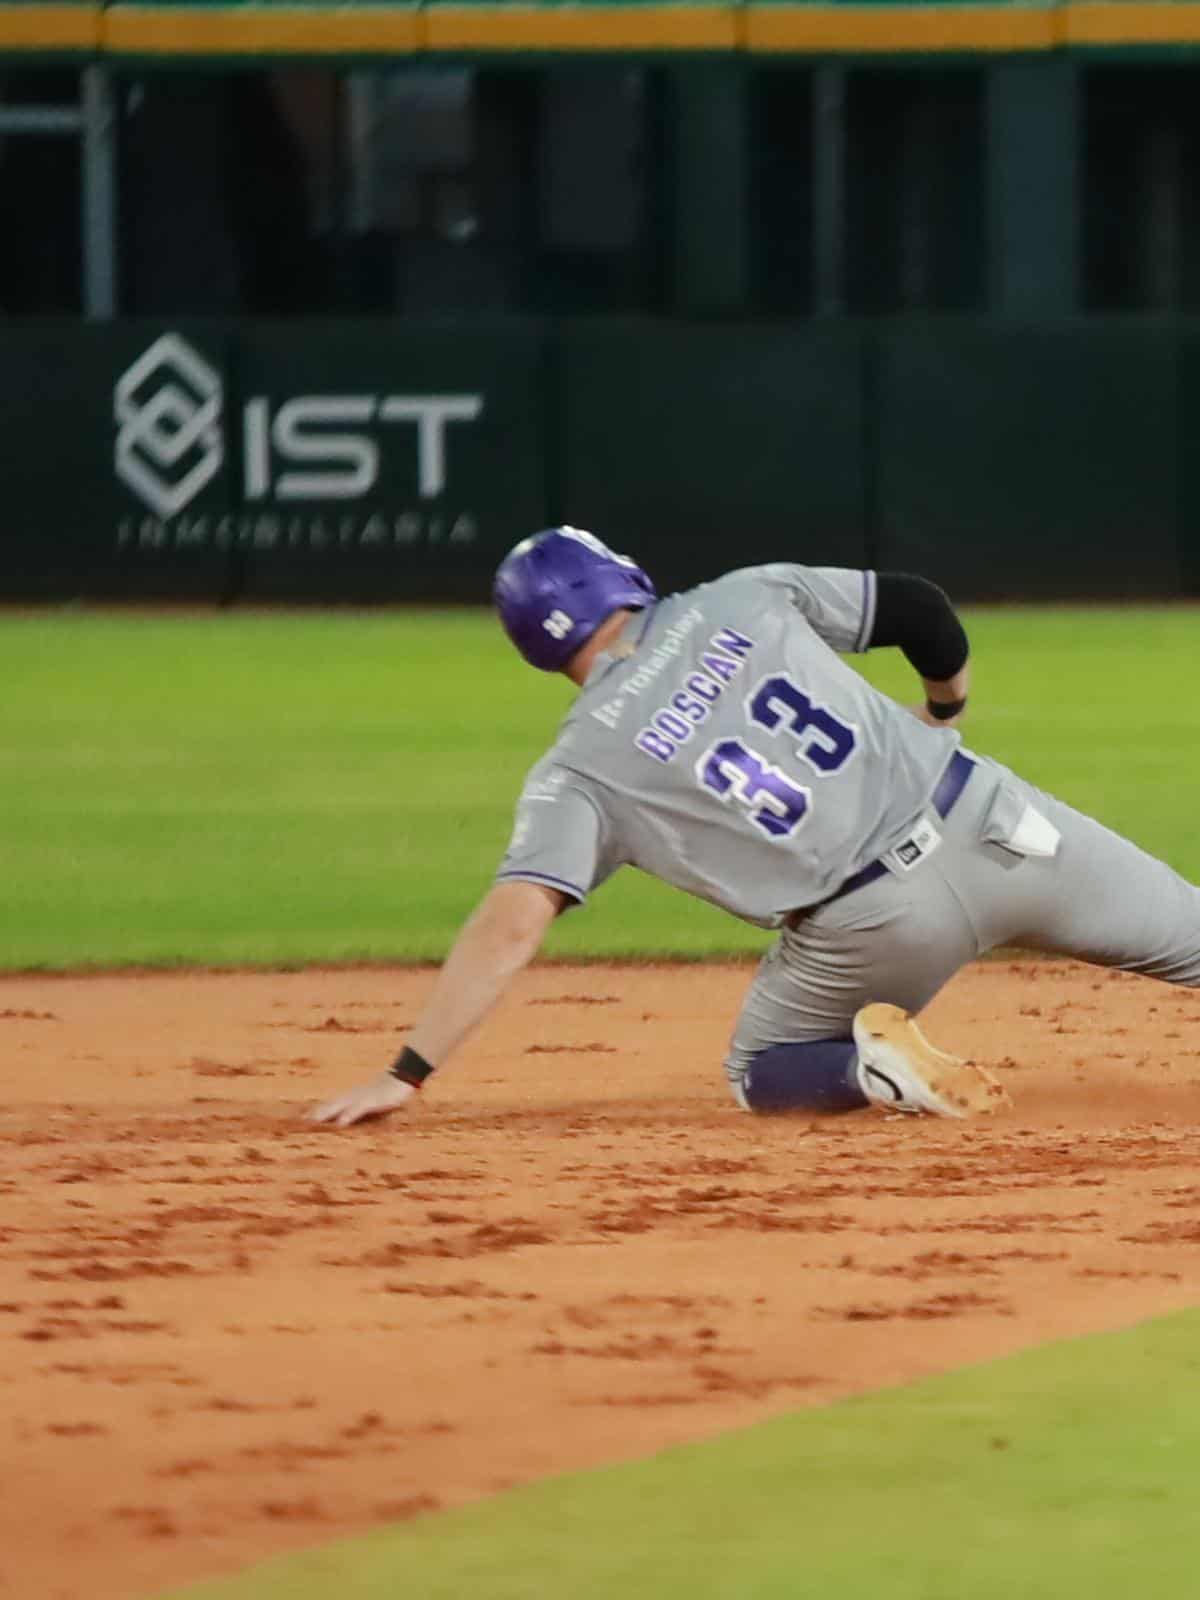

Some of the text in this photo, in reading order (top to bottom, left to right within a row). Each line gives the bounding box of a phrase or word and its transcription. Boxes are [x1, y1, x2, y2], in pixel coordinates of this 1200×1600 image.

[243, 394, 484, 499] IST
[115, 513, 479, 549] INMOBILIARIA
[632, 626, 758, 764] BOSCAN
[694, 671, 860, 843] 33
